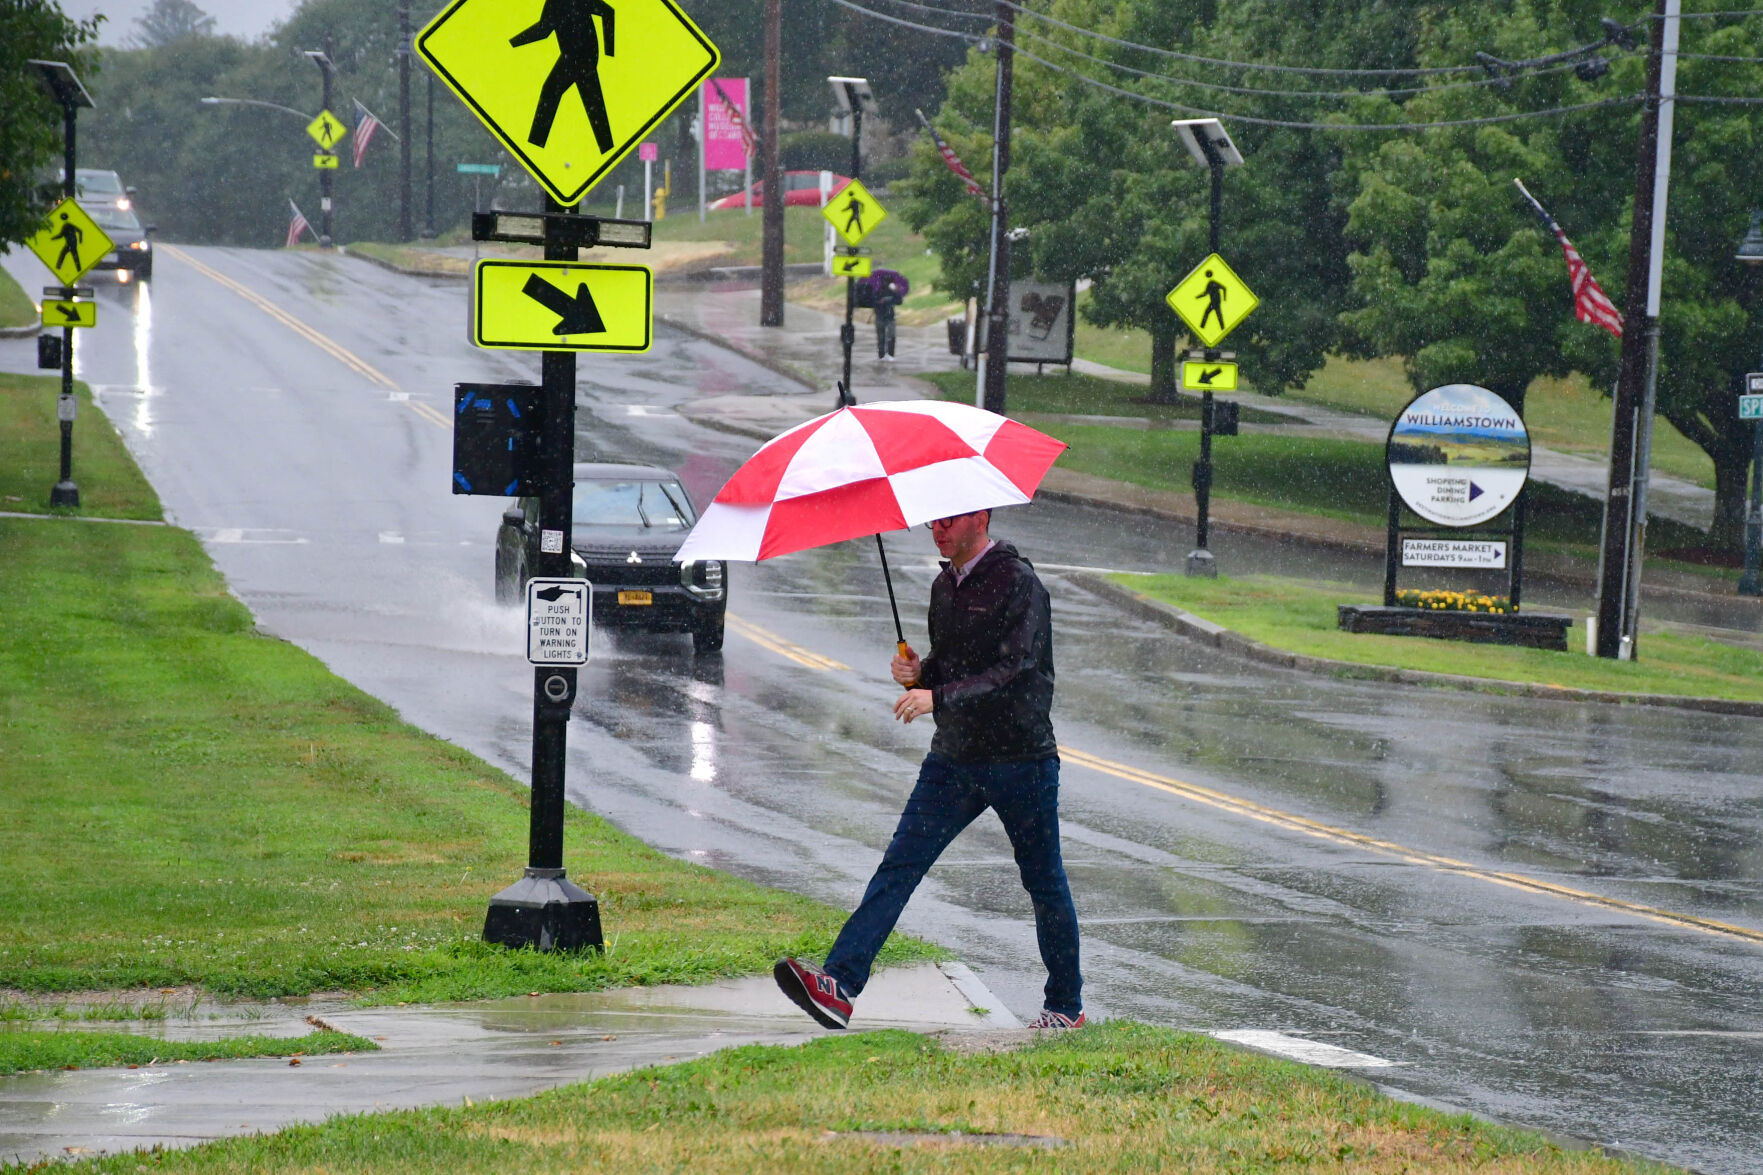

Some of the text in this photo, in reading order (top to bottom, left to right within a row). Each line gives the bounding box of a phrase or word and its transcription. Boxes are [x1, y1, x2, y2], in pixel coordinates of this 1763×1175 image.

[1407, 414, 1515, 429] WILLIAMSTOWN
[1426, 478, 1467, 486] SHOPPING
[1437, 486, 1465, 495] DINING
[1431, 495, 1465, 504] PARKING
[1405, 542, 1493, 553] FARMERS MARKET
[1404, 553, 1455, 562] SATURDAYS
[548, 605, 570, 614] PUSH
[572, 617, 582, 625] TO
[540, 627, 577, 637] TURN ON
[540, 638, 577, 648] WARNING
[543, 650, 572, 659] LIGHTS
